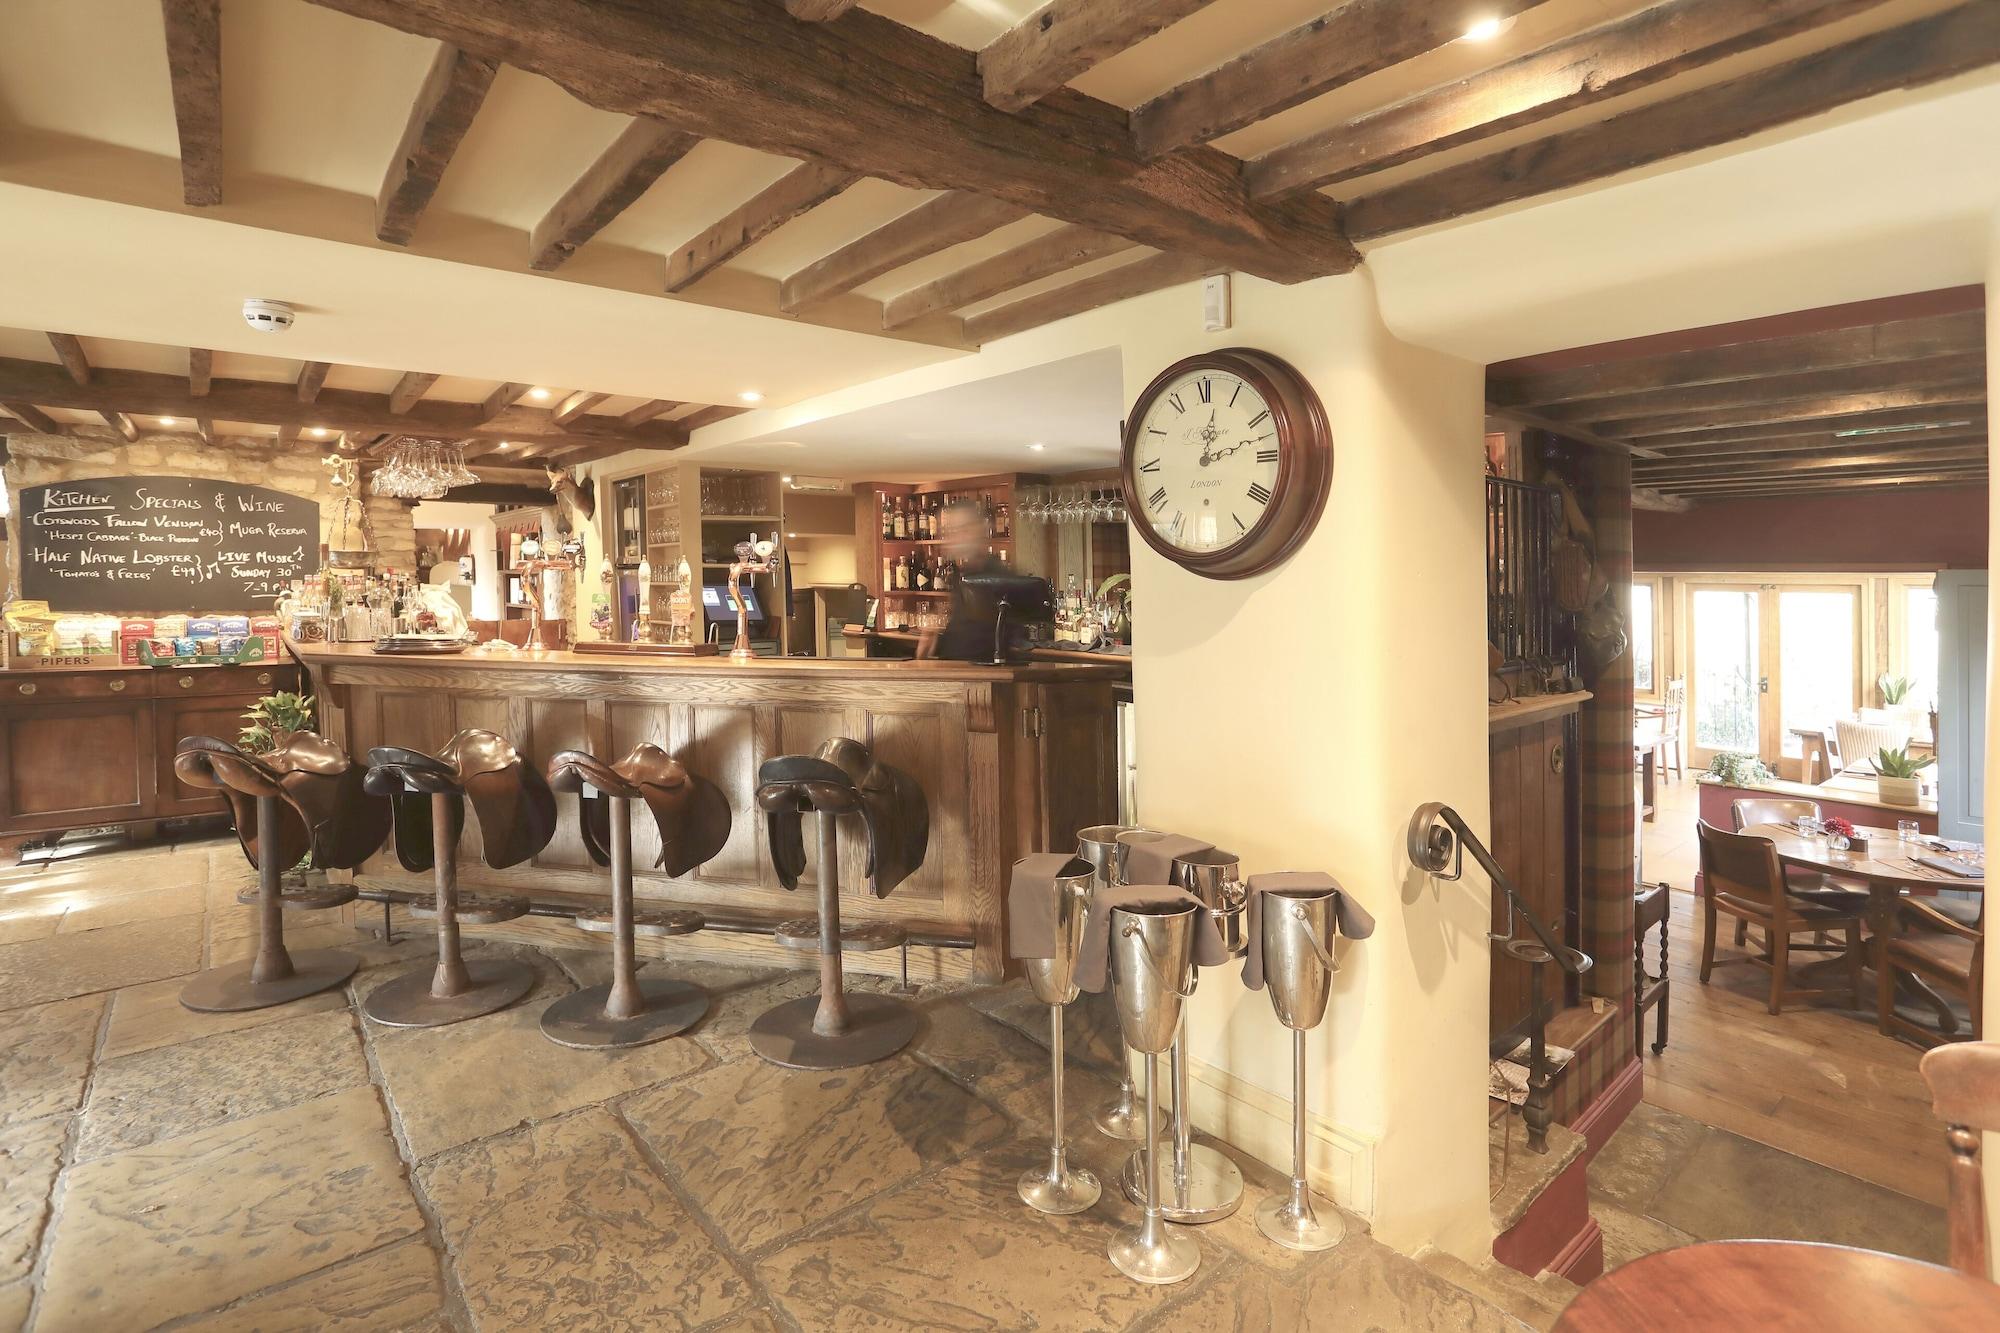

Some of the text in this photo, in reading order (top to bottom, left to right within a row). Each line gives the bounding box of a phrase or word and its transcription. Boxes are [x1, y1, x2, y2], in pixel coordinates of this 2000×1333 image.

[1190, 479, 1223, 489] LONDON
[43, 488, 112, 508] KITCHEN
[130, 488, 202, 510] SPECIALS
[237, 495, 285, 512] WINE
[229, 522, 308, 538] MUGA RESERVA
[80, 547, 127, 565] NATIVE
[132, 549, 193, 565] LOBSTER
[217, 551, 295, 564] LIVE MUSIC
[231, 565, 271, 579] SUNDAY
[41, 656, 91, 666] PIPERS
